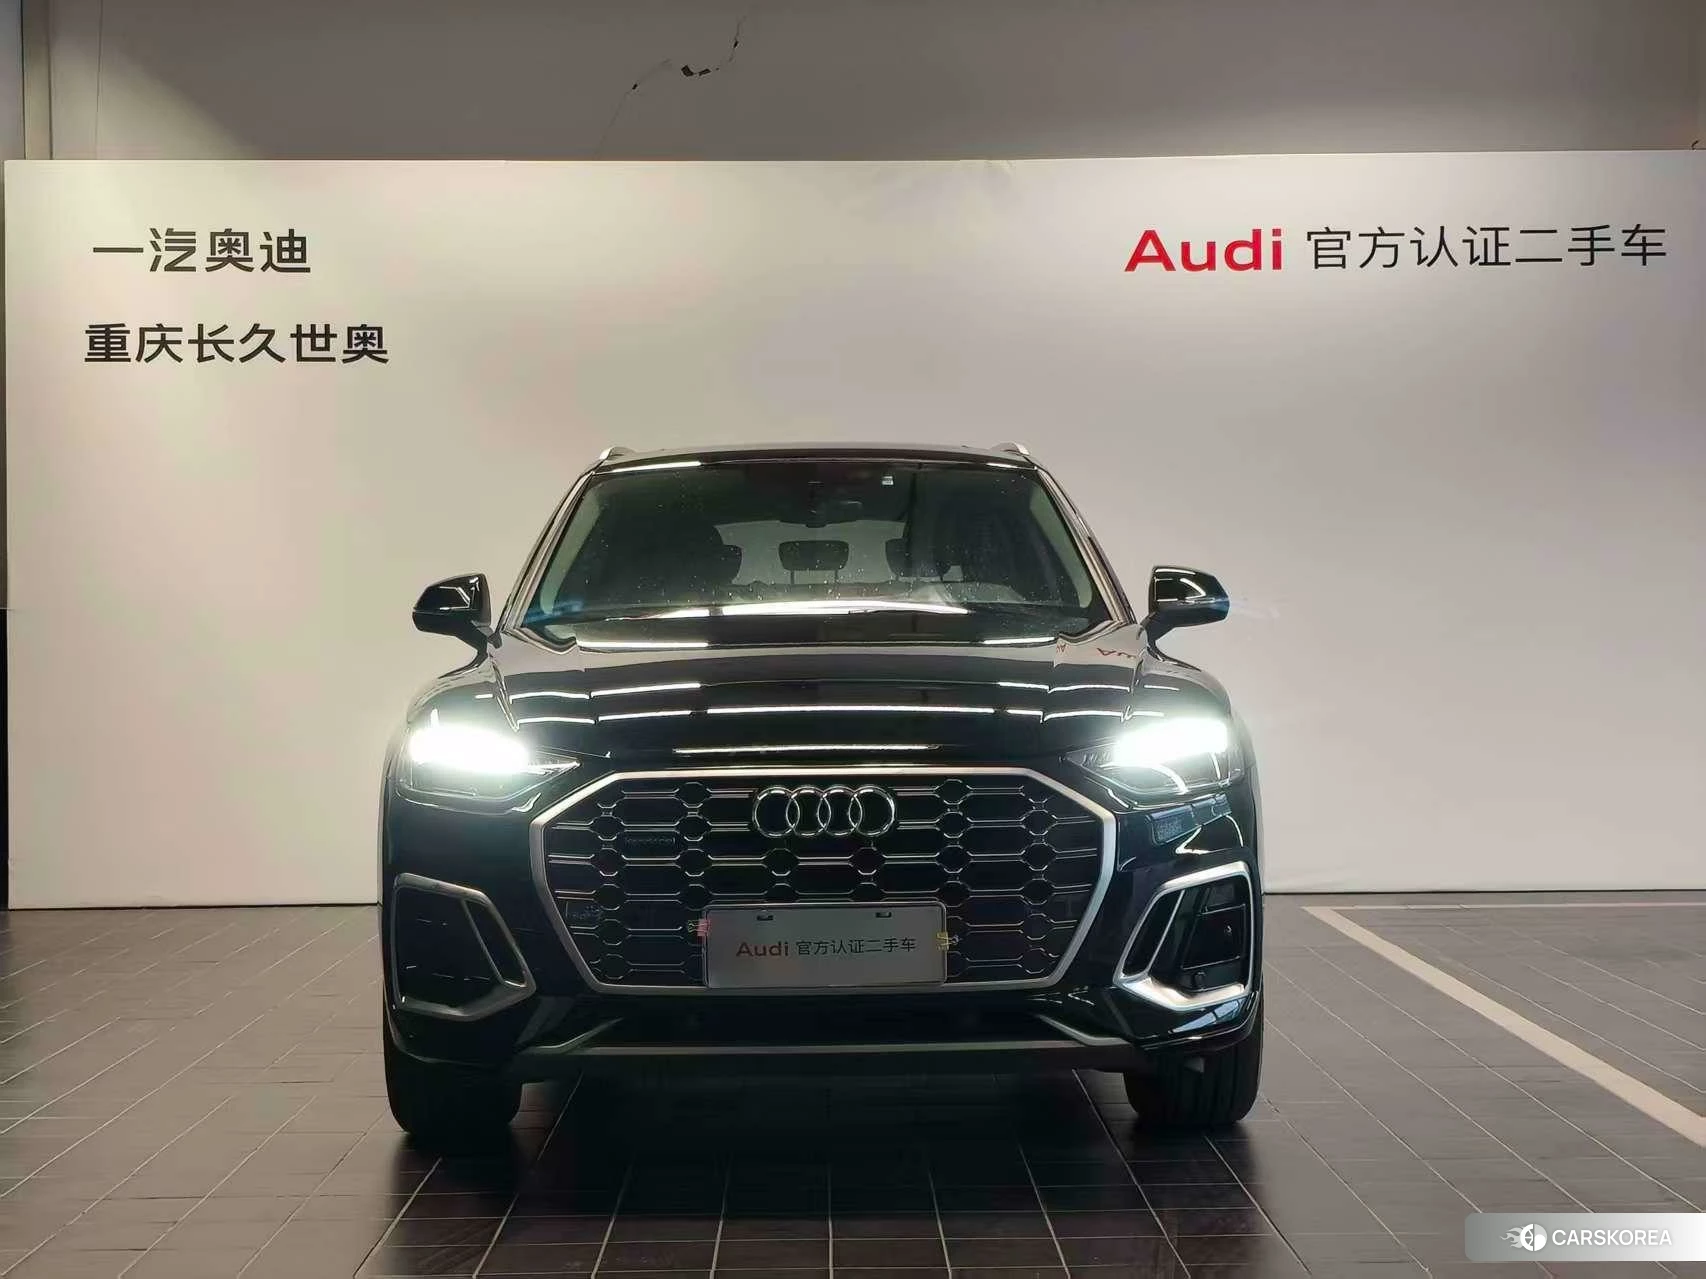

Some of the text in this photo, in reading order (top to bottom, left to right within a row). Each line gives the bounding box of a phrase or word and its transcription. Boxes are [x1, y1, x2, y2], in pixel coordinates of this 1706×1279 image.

[93, 227, 312, 274] 一汽奥迪
[1124, 223, 1668, 272] Audi 官方认证二手车
[84, 323, 390, 365] 重庆长久世奥
[736, 937, 917, 957] Audi 官方认证二手车
